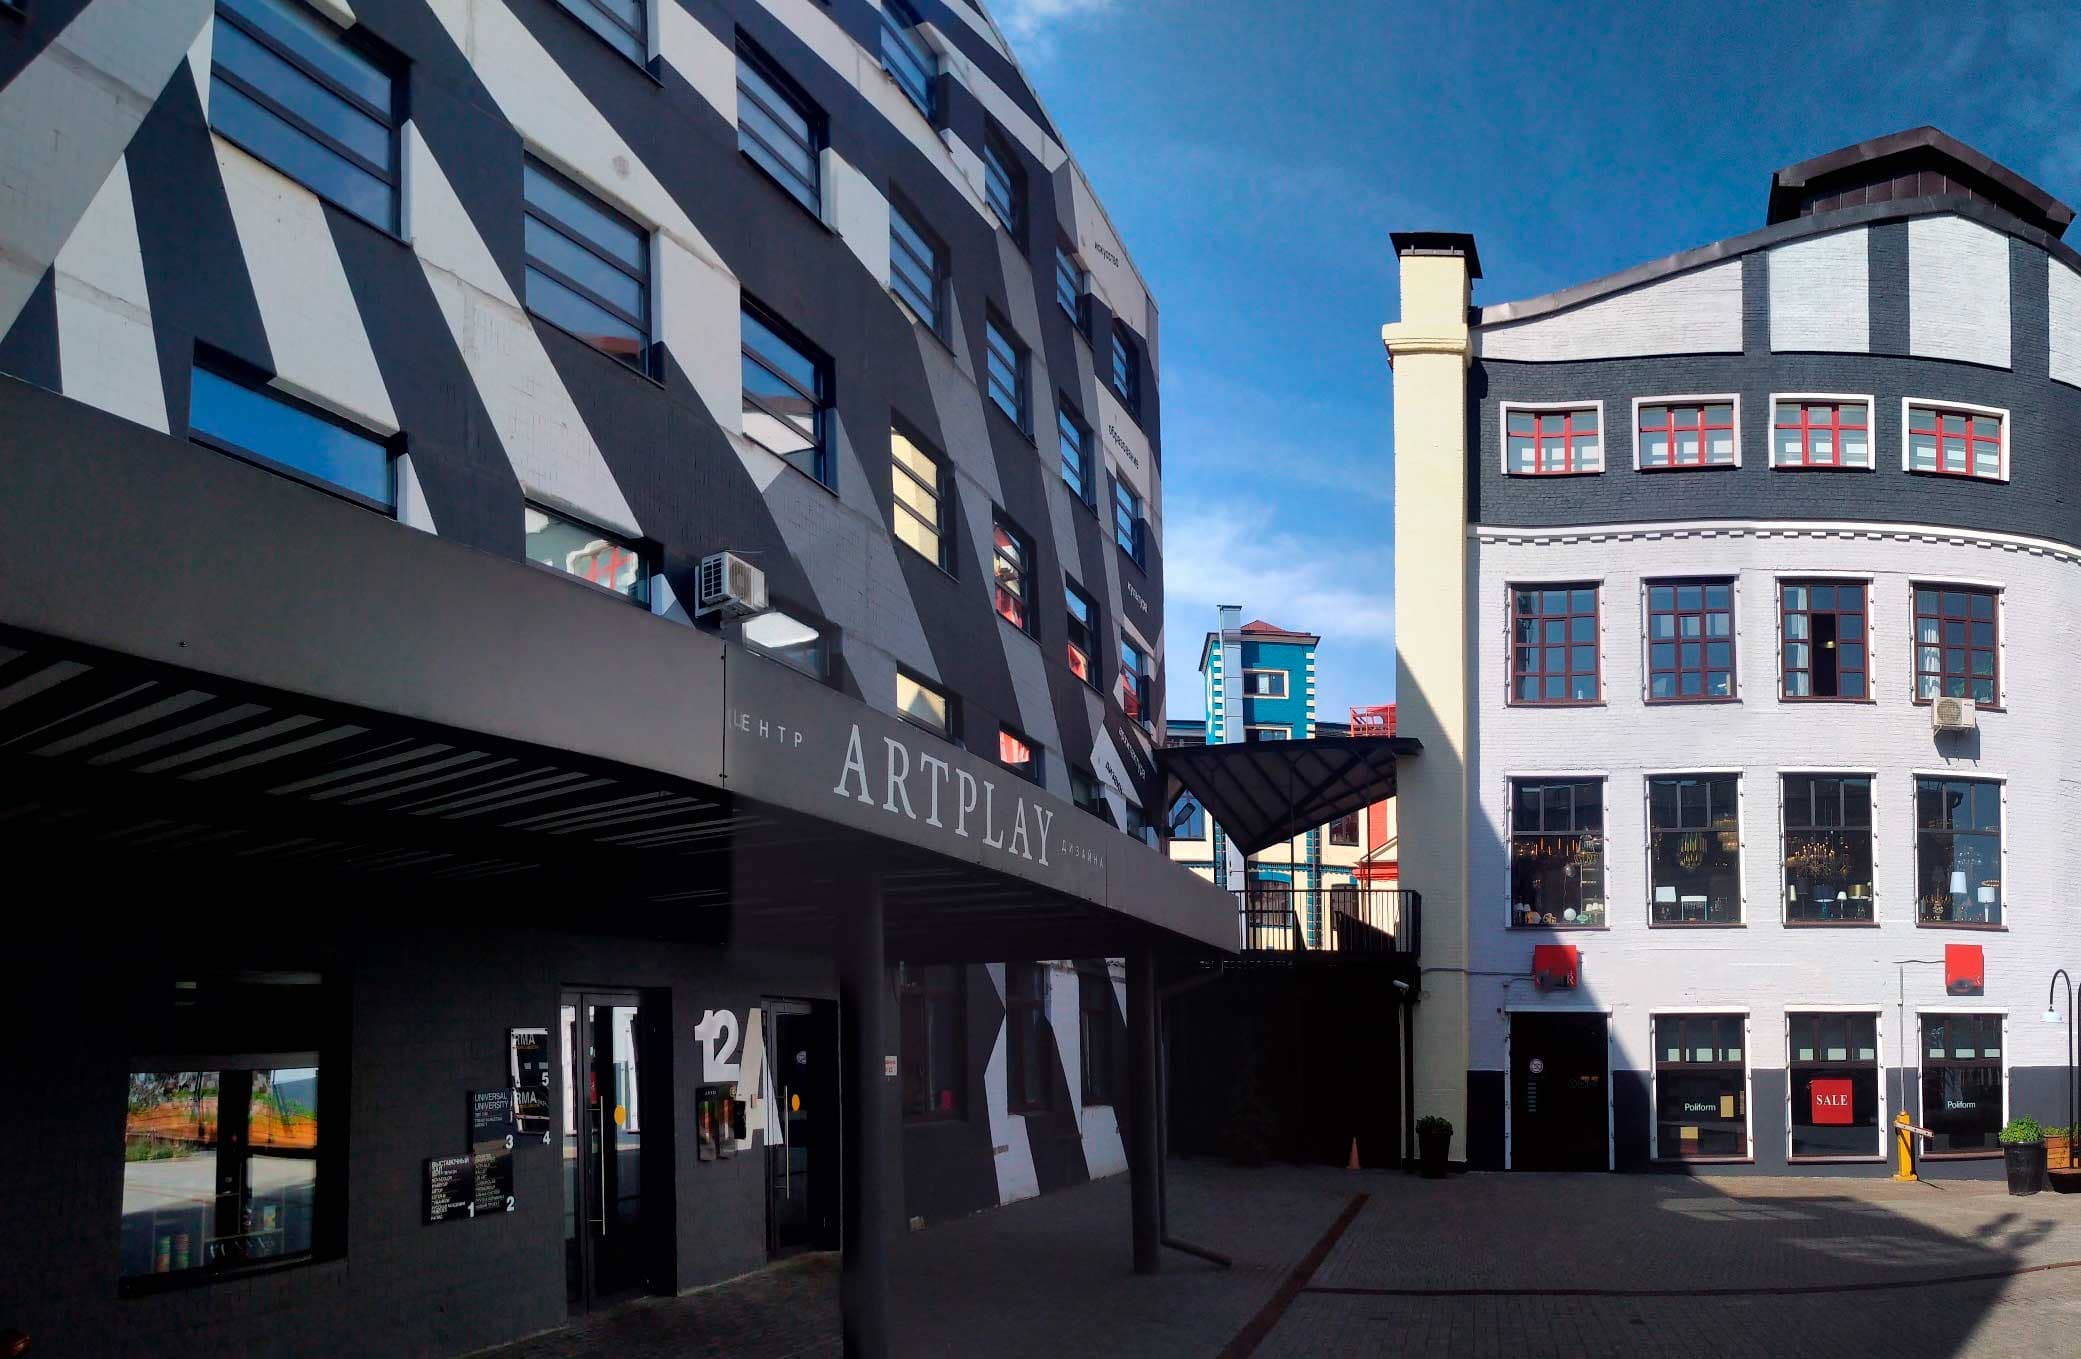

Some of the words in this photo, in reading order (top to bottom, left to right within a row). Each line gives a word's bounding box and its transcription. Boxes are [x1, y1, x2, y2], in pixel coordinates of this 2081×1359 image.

[833, 723, 1054, 867] ARTPLAY
[541, 1071, 550, 1087] 5
[1684, 1102, 1717, 1112] Poliform
[1816, 1094, 1848, 1106] SALE
[1947, 1100, 1976, 1109] Poliform
[505, 1134, 514, 1149] 3
[542, 1130, 551, 1145] 4
[467, 1201, 475, 1218] 1
[506, 1195, 515, 1212] 2
